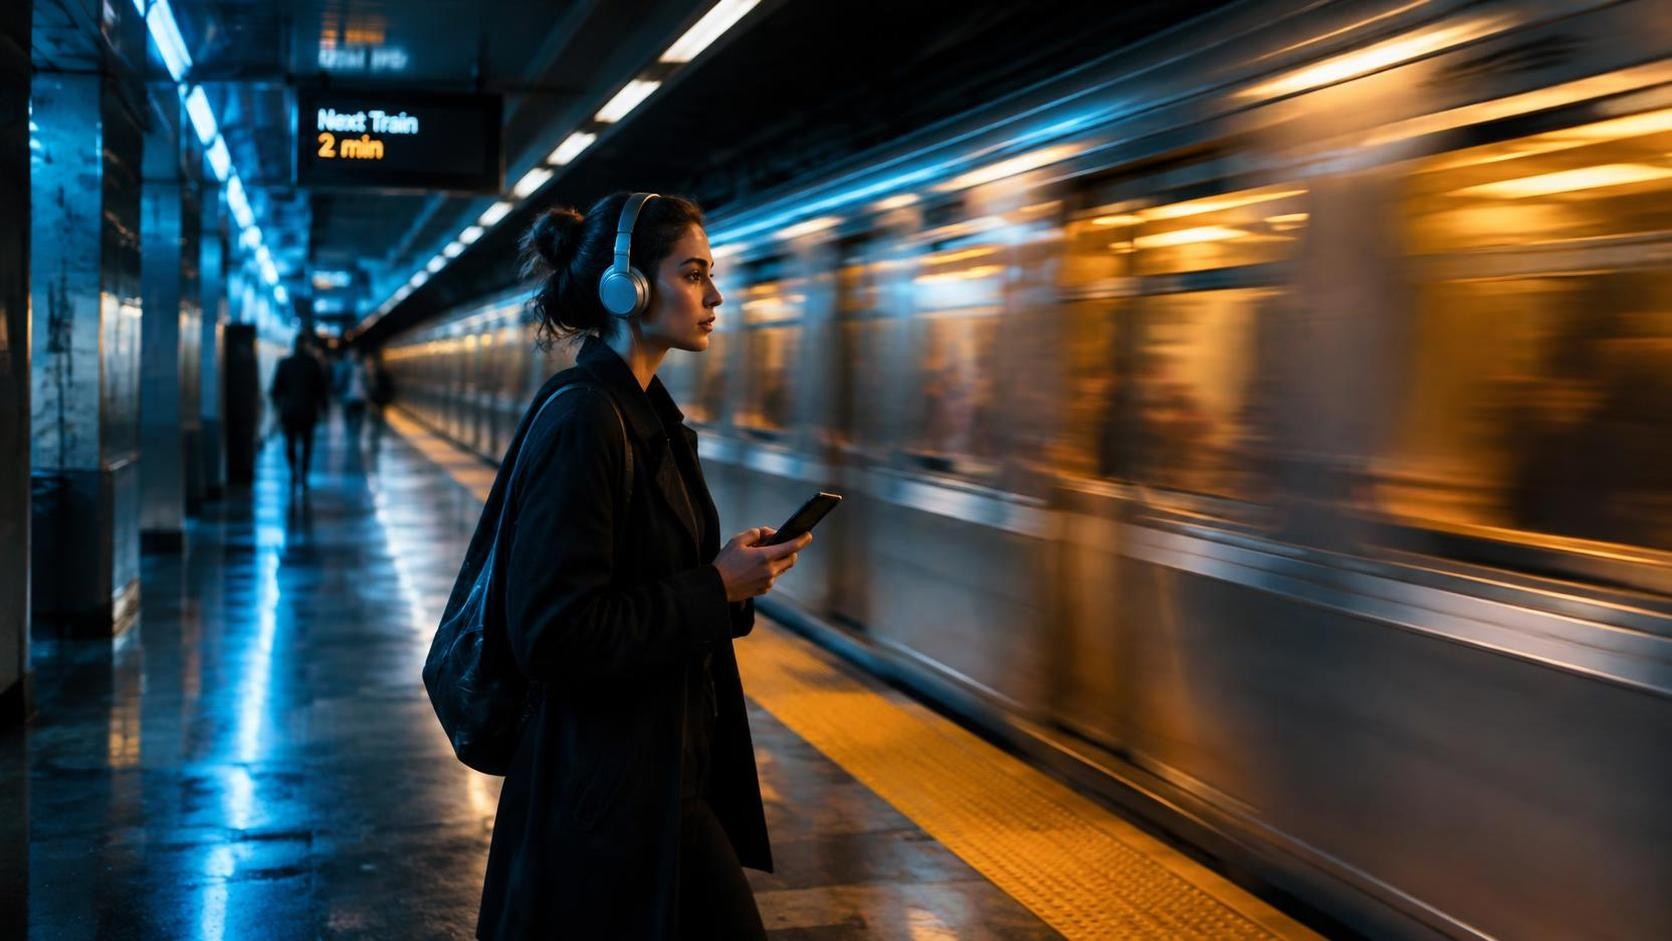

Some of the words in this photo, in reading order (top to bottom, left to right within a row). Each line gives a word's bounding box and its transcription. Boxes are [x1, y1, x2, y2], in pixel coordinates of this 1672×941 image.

[317, 108, 366, 132] Next
[368, 110, 418, 134] Train
[317, 132, 336, 157] 2
[340, 134, 384, 159] min
